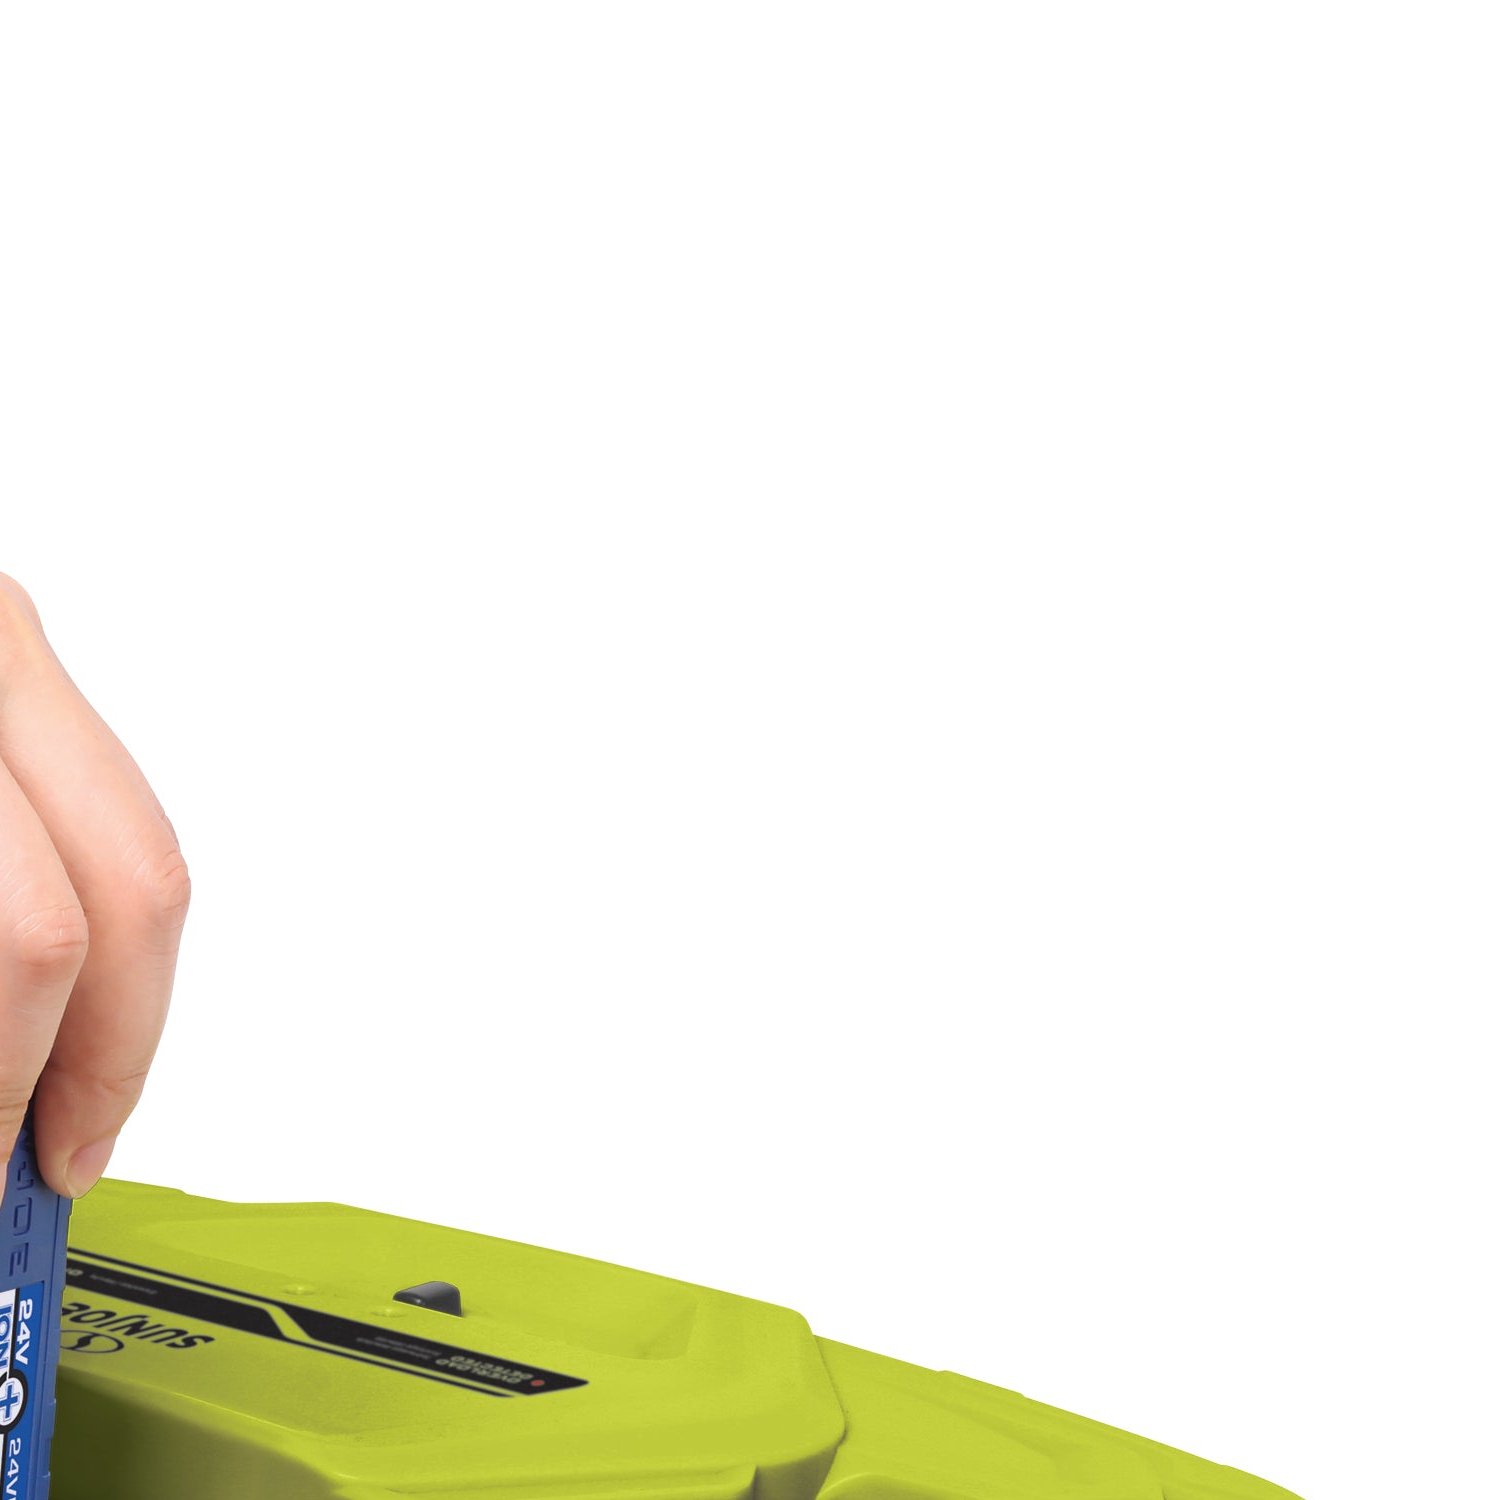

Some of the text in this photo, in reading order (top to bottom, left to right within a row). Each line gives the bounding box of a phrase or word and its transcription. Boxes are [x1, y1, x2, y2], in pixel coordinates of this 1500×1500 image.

[15, 1298, 33, 1365] 24V
[435, 1358, 522, 1384] OVERLOAD
[450, 1355, 534, 1380] DETECTED
